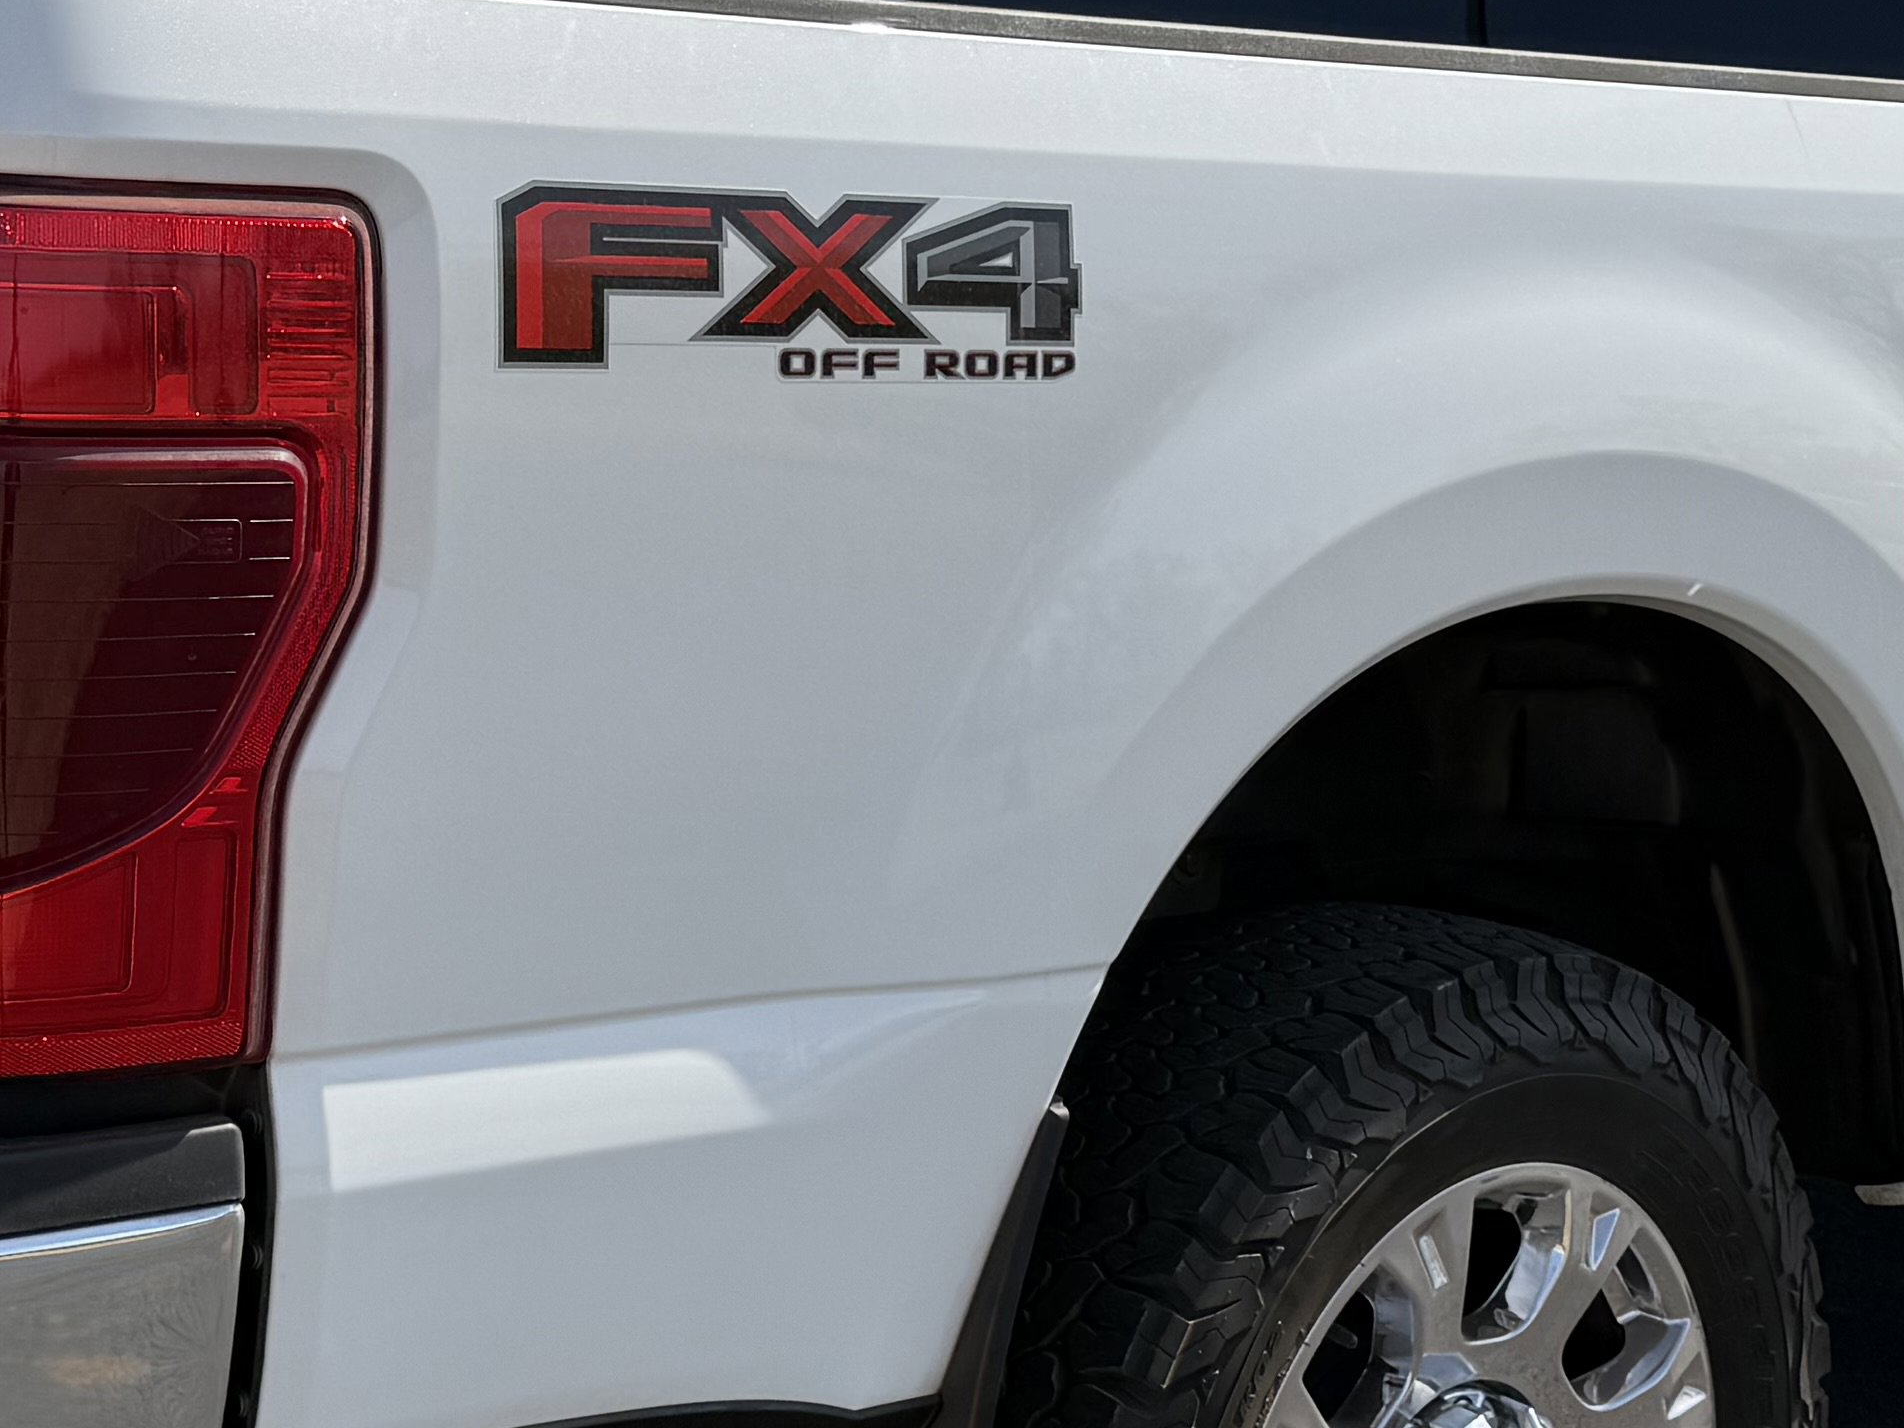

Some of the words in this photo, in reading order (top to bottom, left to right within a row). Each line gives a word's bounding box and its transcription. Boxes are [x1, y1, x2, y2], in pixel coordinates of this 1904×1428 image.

[495, 179, 1082, 372] FX4
[777, 347, 901, 381] OFF
[923, 348, 1077, 382] ROAD
